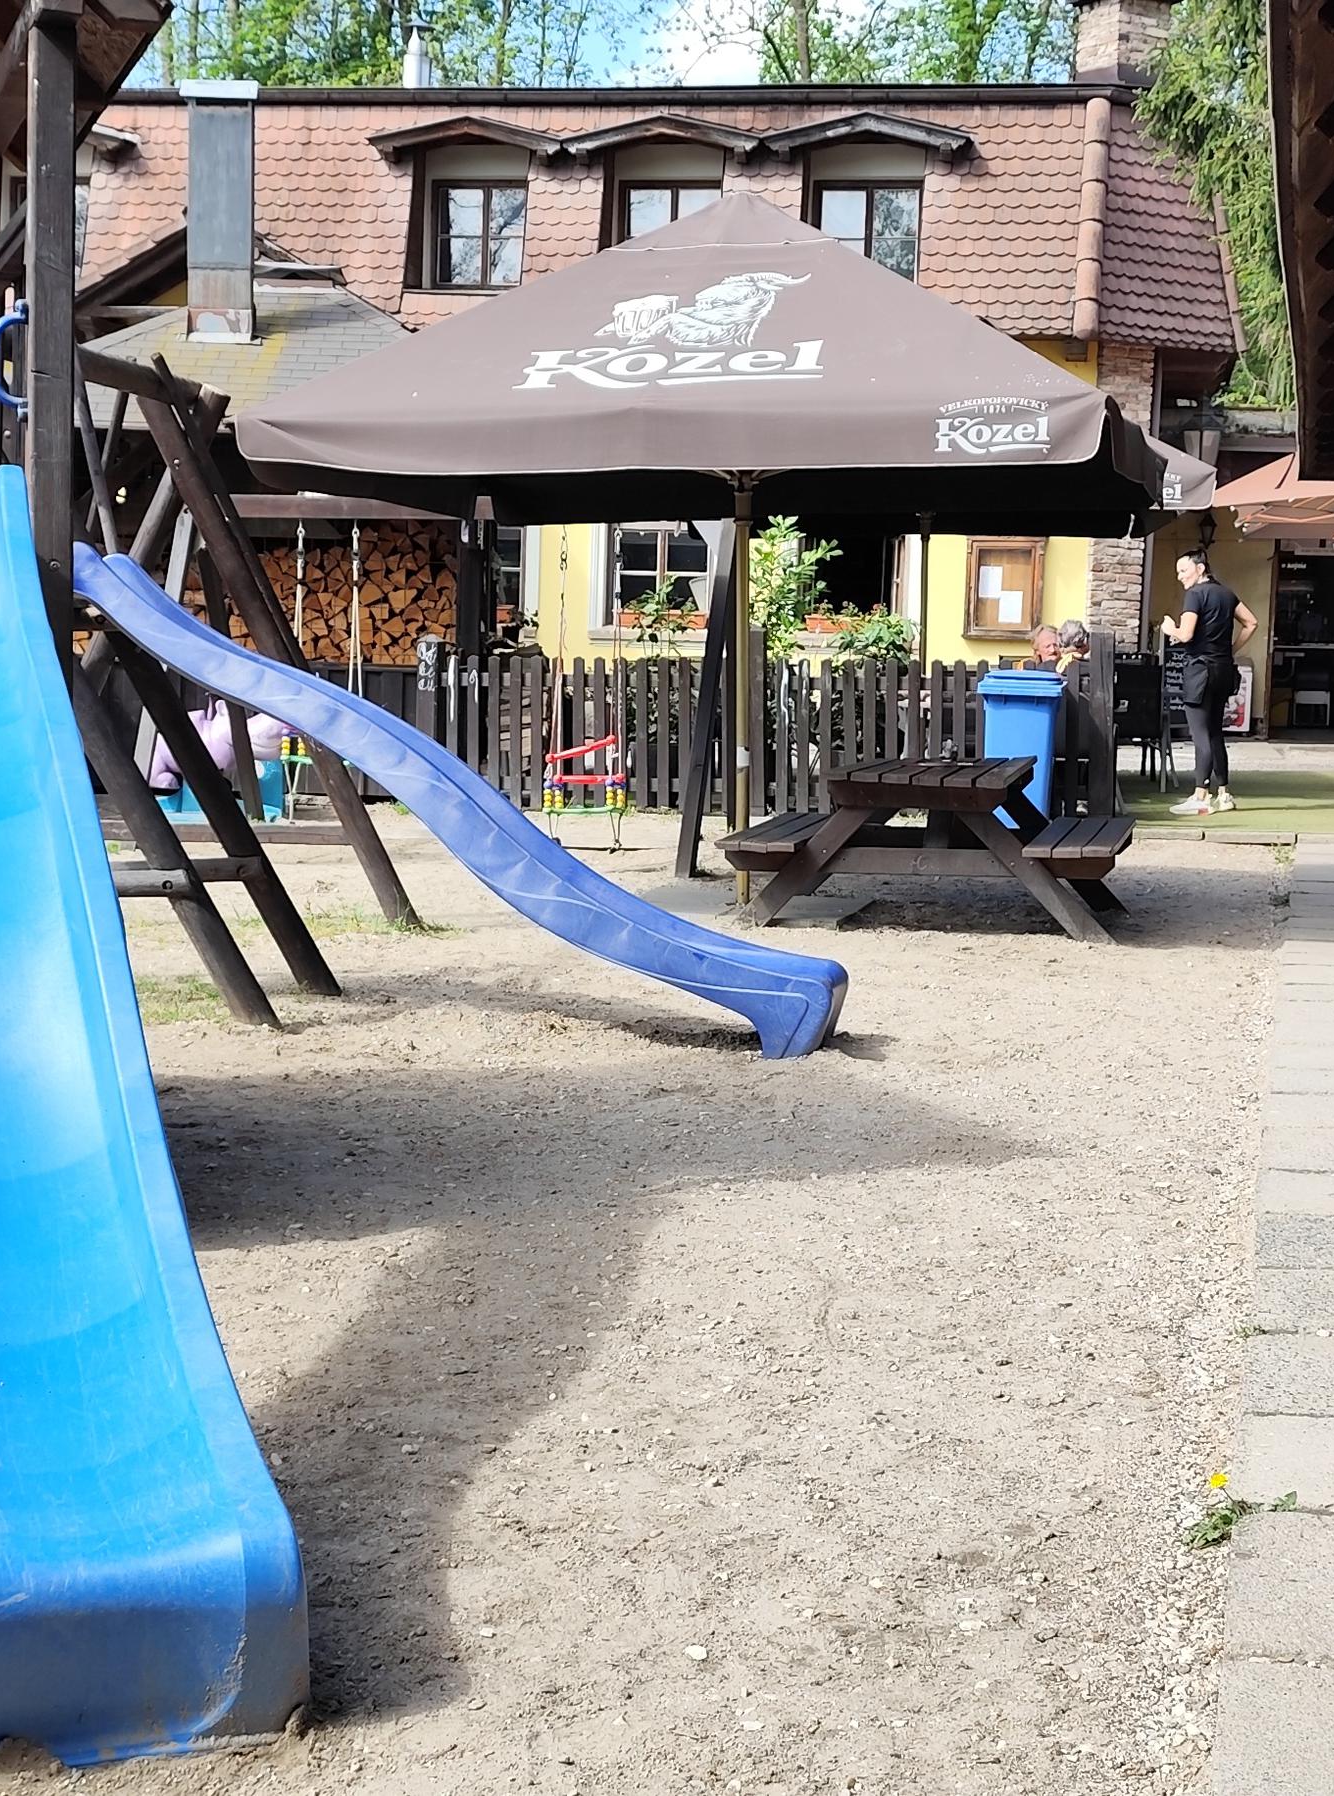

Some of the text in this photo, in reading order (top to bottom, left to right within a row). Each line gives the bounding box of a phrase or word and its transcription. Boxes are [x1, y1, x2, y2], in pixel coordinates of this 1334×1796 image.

[511, 339, 825, 389] Kozel
[938, 396, 1049, 414] VELKOPOPOVICKÝ
[934, 415, 1051, 454] Kozel
